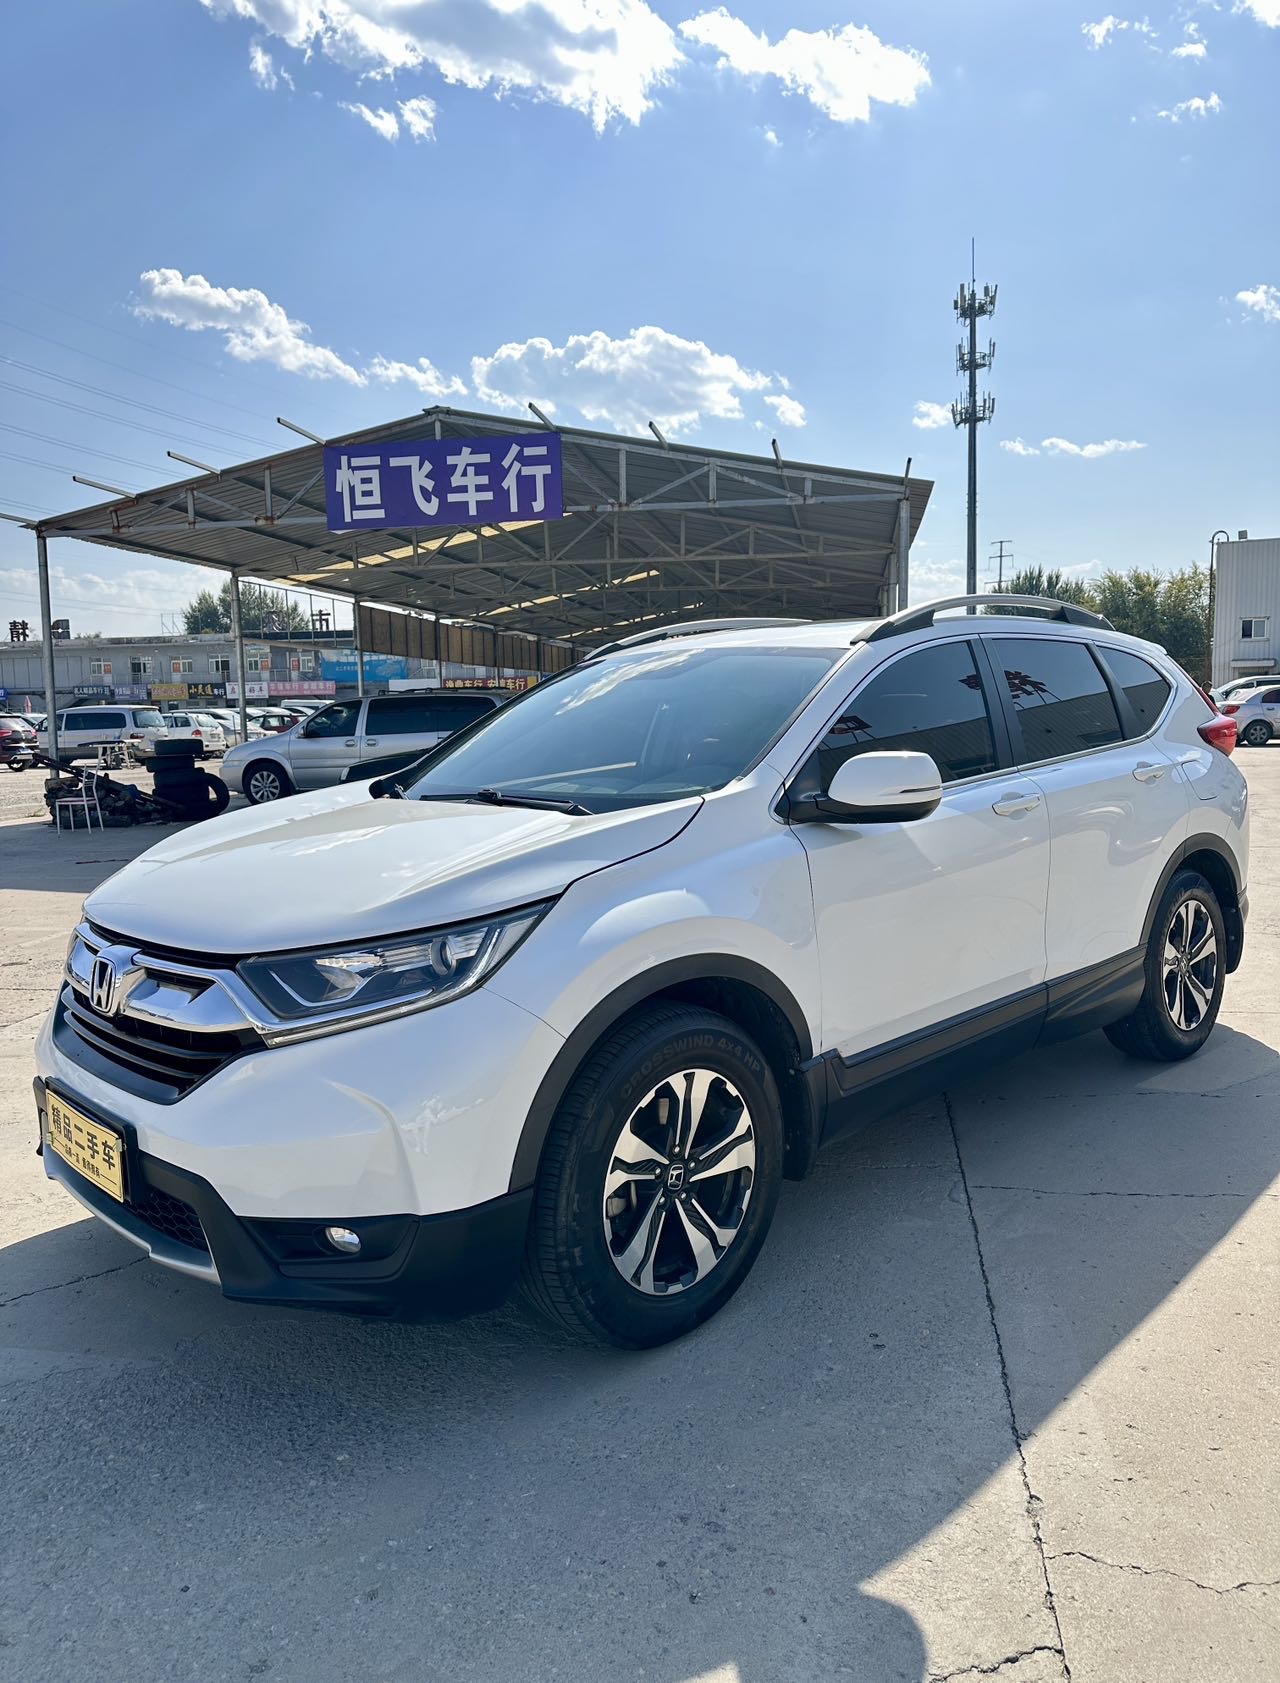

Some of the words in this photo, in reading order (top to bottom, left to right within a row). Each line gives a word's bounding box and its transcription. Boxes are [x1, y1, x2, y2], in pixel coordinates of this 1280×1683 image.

[336, 443, 551, 522] 恒飞车行
[622, 1034, 714, 1097] CROSSWIND
[744, 1052, 761, 1072] HP
[52, 1104, 116, 1170] 精品二手车
